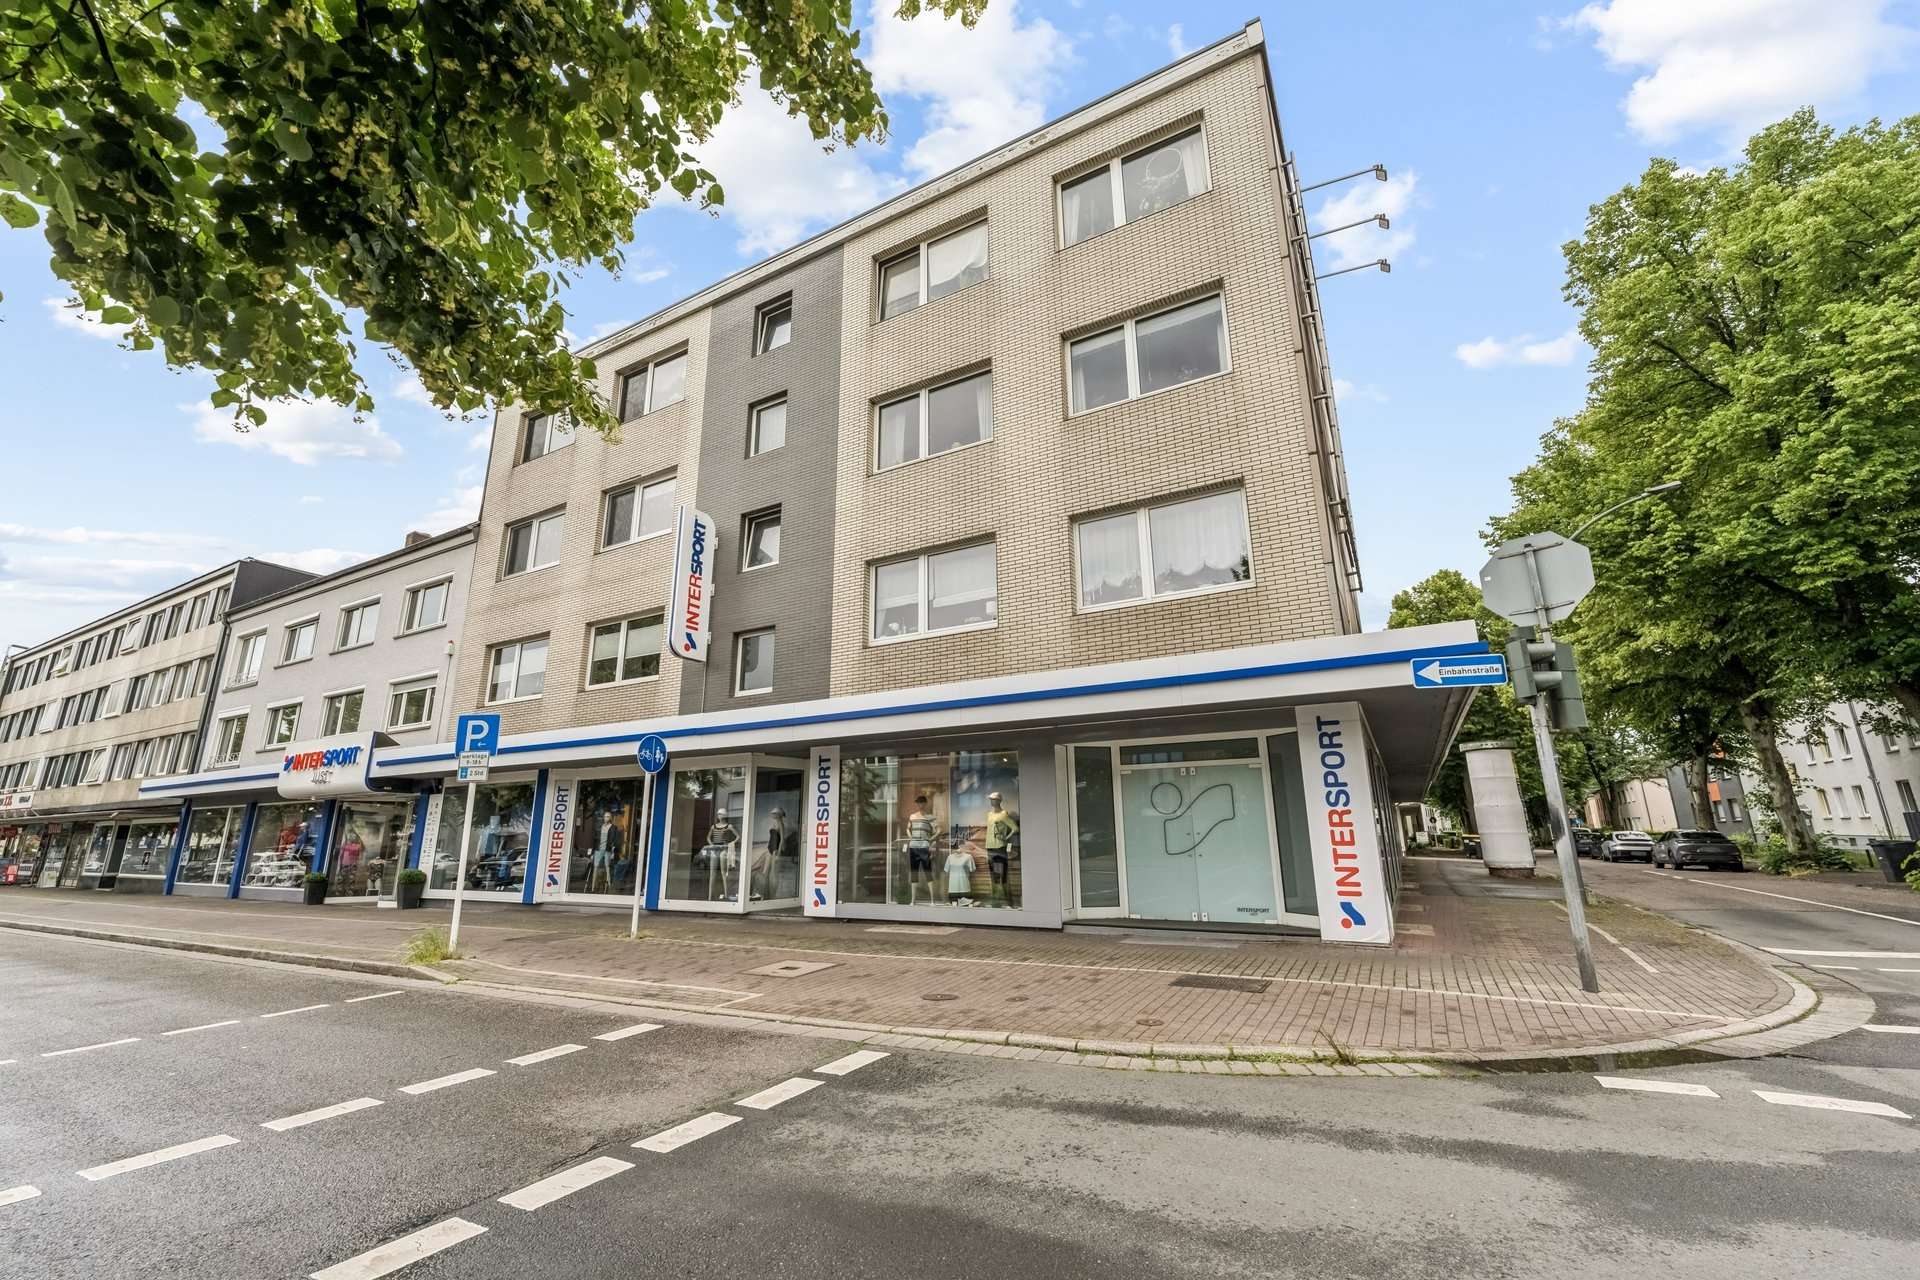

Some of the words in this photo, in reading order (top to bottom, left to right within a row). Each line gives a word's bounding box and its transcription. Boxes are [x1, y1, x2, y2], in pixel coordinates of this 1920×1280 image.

[686, 517, 706, 632] INTERSPORT
[1439, 666, 1500, 676] Einbahnstraße
[292, 745, 363, 771] INTERSPORT
[464, 719, 489, 752] P
[548, 785, 569, 872] INTERSPORT
[814, 754, 832, 885] INTERSPORT
[1316, 715, 1363, 897] INTERSPORT
